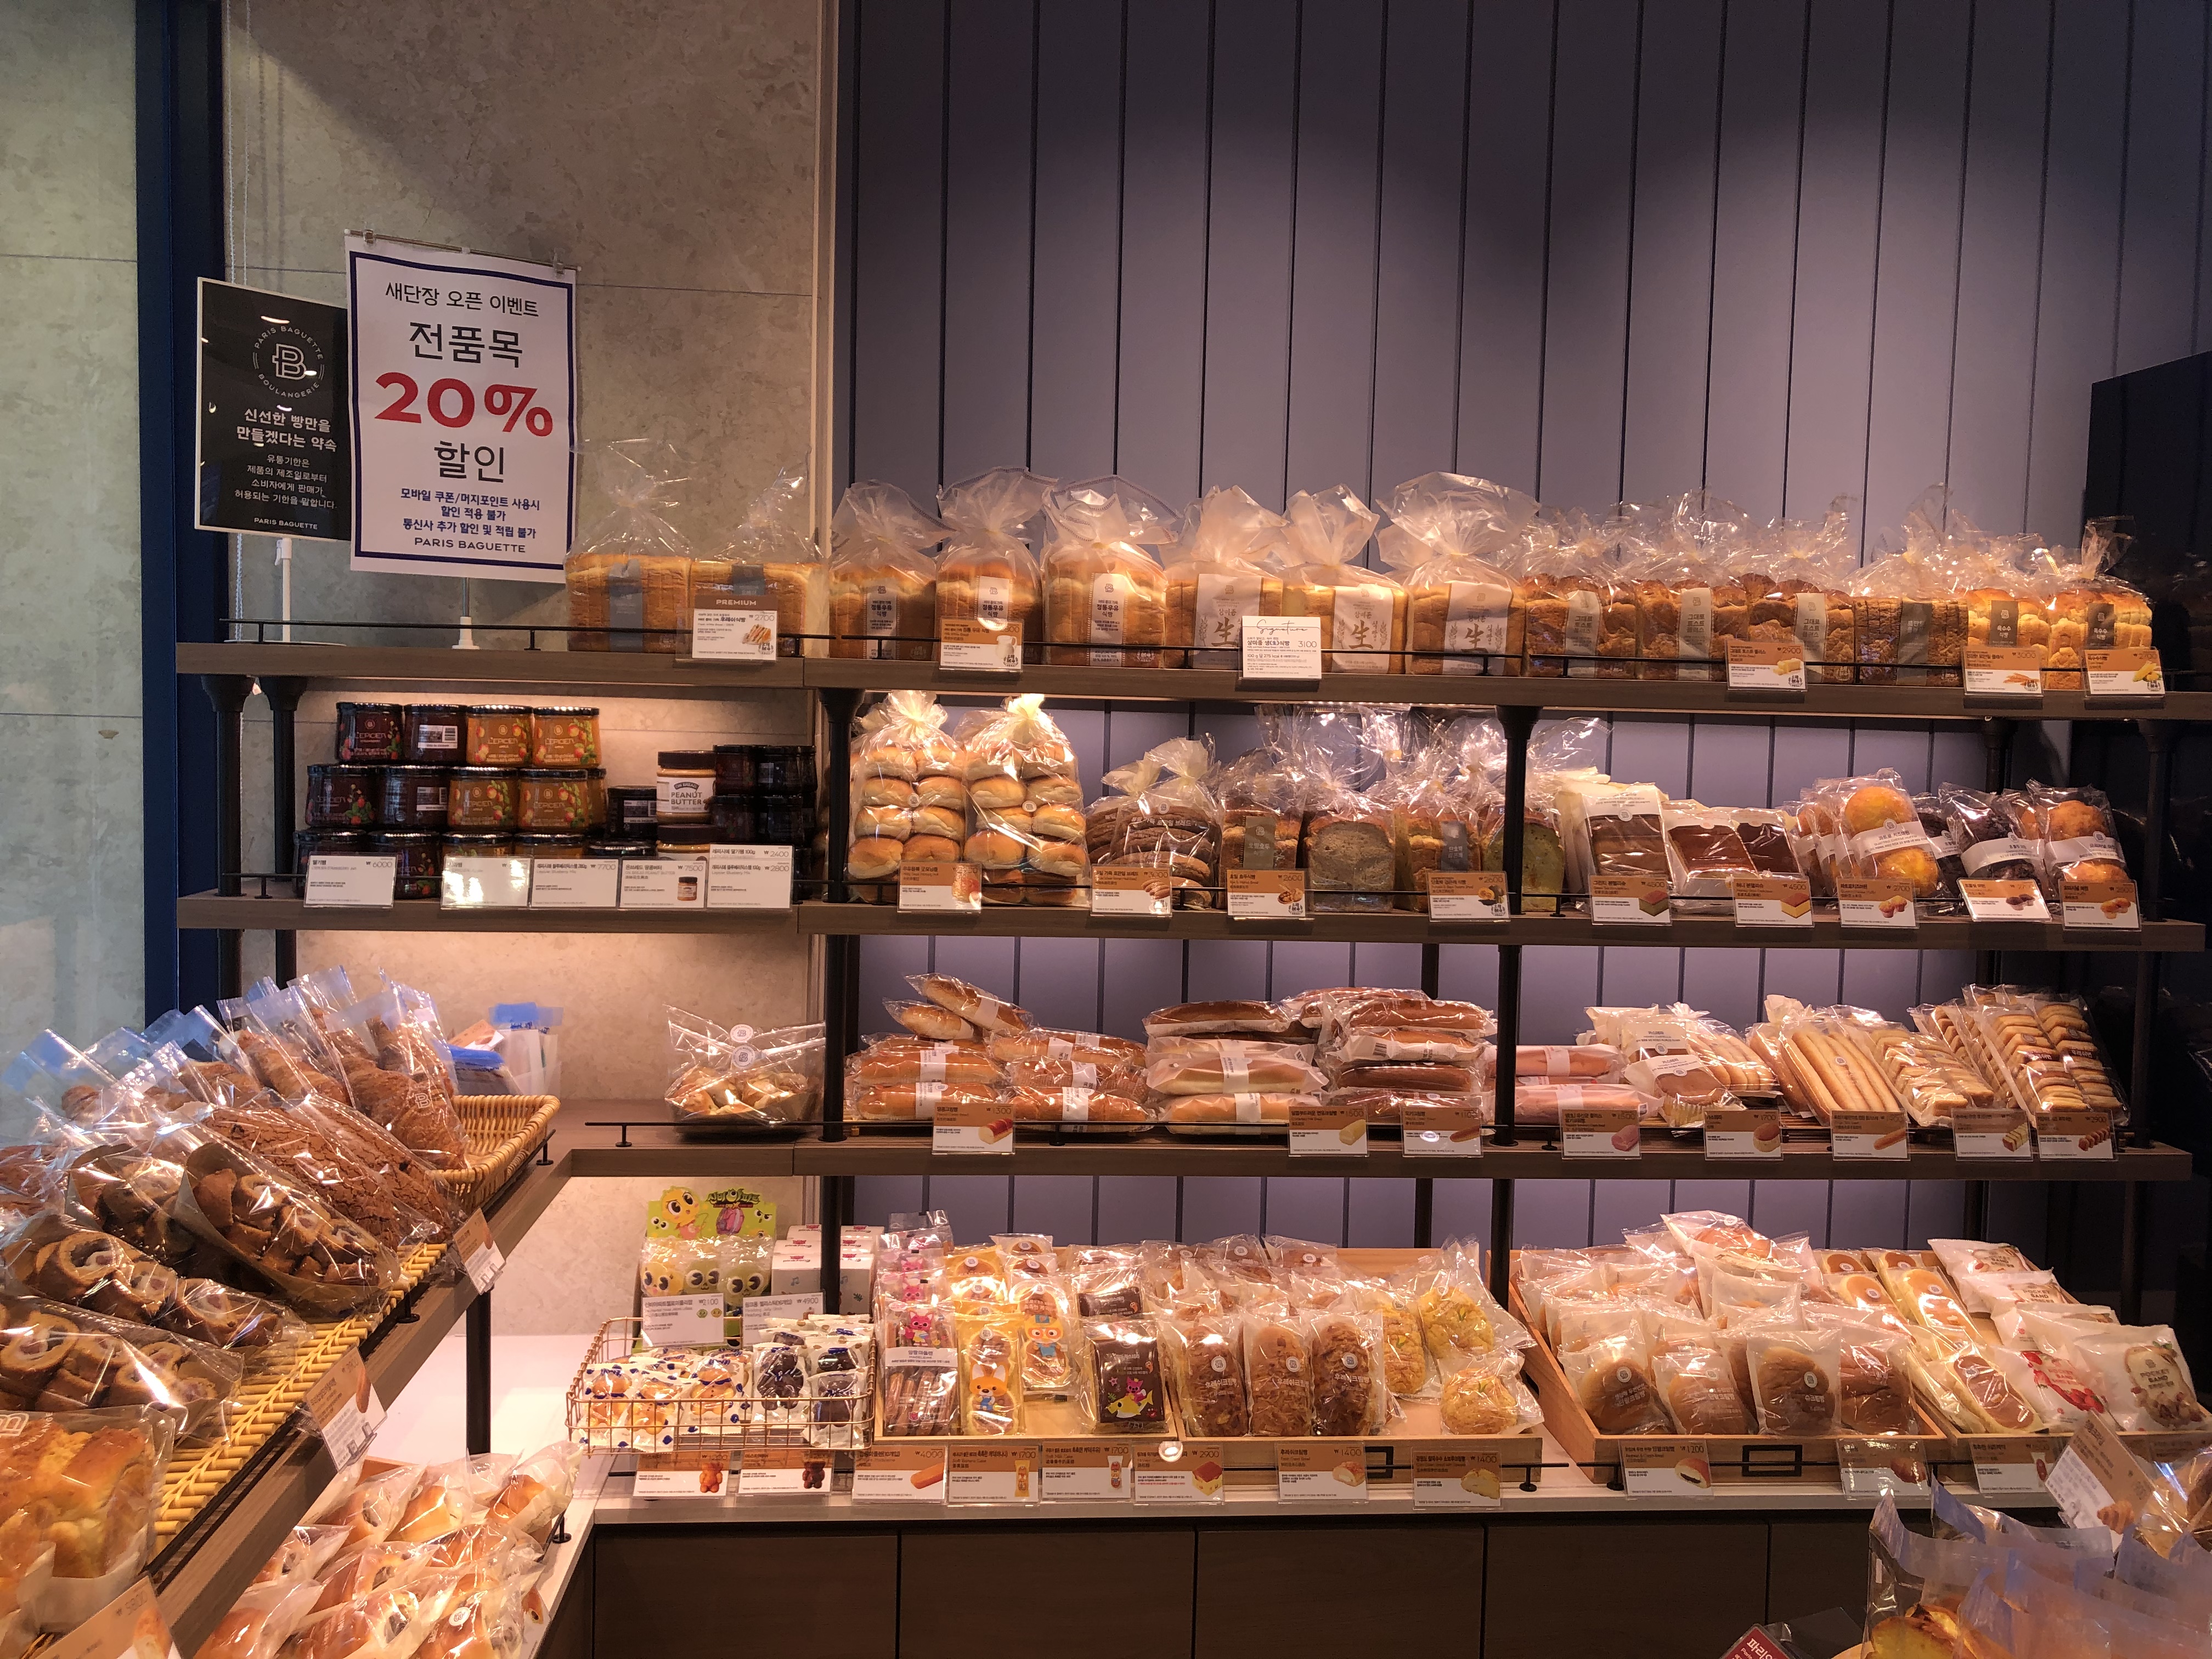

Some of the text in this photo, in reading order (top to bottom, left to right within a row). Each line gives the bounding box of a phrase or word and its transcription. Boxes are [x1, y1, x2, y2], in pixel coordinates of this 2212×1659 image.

[385, 282, 539, 317] 새단장 오픈 이벤트
[255, 326, 324, 360] PARIS BAGUETTE
[409, 322, 522, 368] 전품목
[258, 374, 319, 398] BOULANGERIE
[374, 372, 553, 437] 20%
[245, 408, 331, 433] 신선한 빵만을
[236, 426, 337, 452] 만들겠다는 약속
[267, 454, 310, 468] 유통기한은
[434, 440, 504, 483] 할인
[247, 465, 328, 483] 제품의 제조일로부터
[235, 489, 270, 502] 허용되는
[273, 494, 298, 505] 기한을
[251, 479, 323, 495] 소비자에게 판매가
[400, 488, 431, 501] 모바일
[512, 499, 540, 511] 사용시
[279, 520, 318, 529] BAGUETTE
[441, 505, 506, 521] 할인 적용 불가
[403, 518, 536, 539] 통신사 추가 할인 및 적립 불가
[414, 537, 526, 553] PARIS BAGUETTE
